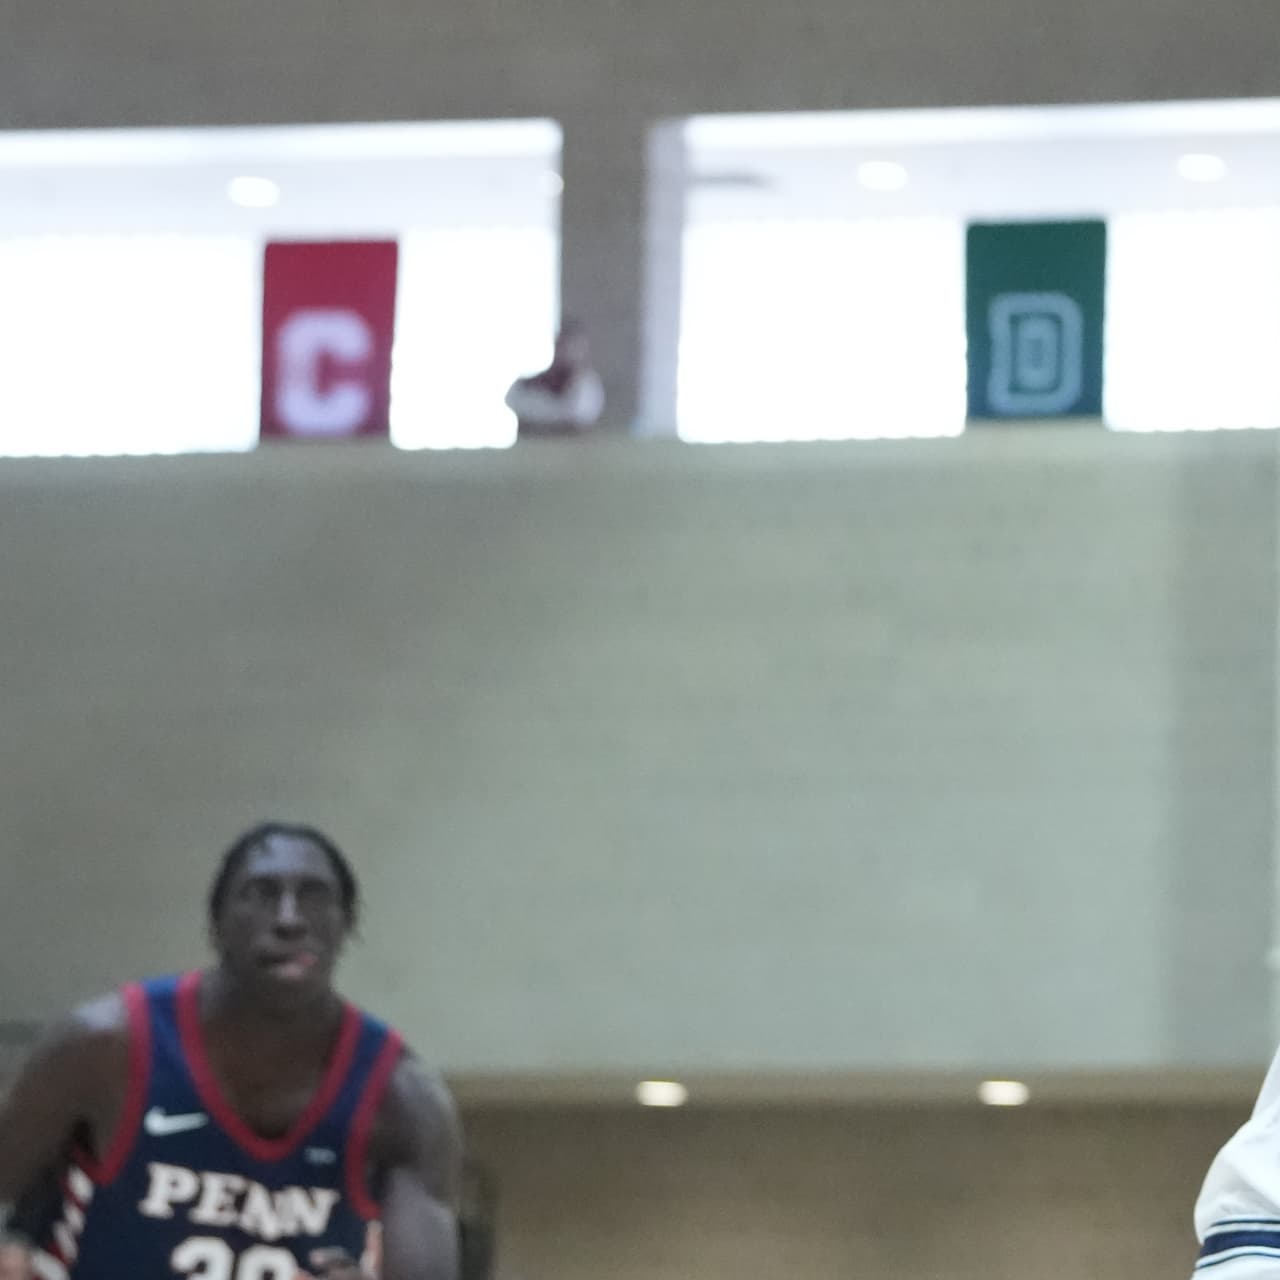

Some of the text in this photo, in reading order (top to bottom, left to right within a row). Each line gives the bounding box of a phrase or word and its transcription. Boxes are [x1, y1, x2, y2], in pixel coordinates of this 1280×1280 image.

[277, 310, 371, 434] C
[988, 293, 1082, 414] D
[137, 1161, 341, 1241] PENN
